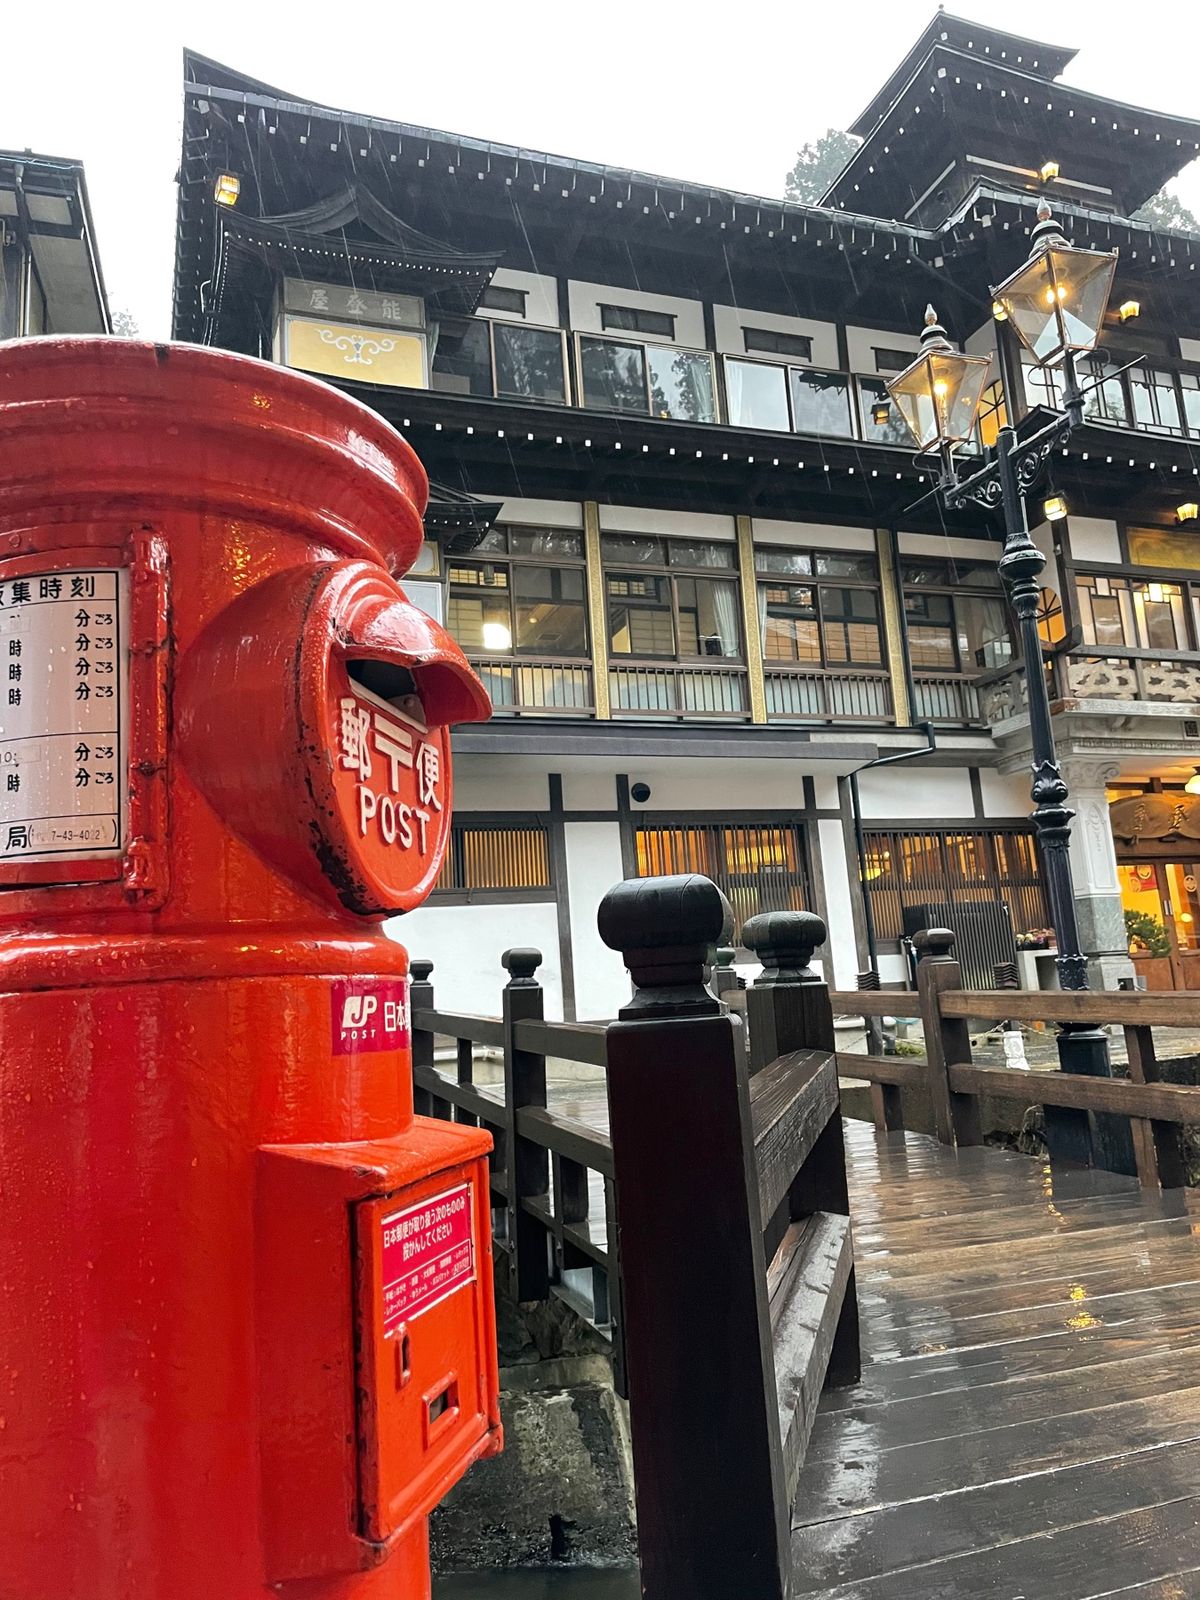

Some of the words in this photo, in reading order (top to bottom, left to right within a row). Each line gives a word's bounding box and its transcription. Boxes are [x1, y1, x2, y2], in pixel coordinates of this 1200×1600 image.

[9, 639, 22, 658] 時
[8, 663, 22, 683] 時
[8, 687, 22, 707] 時
[7, 773, 21, 793] 時
[359, 785, 431, 855] POST
[340, 1029, 376, 1041] POST
